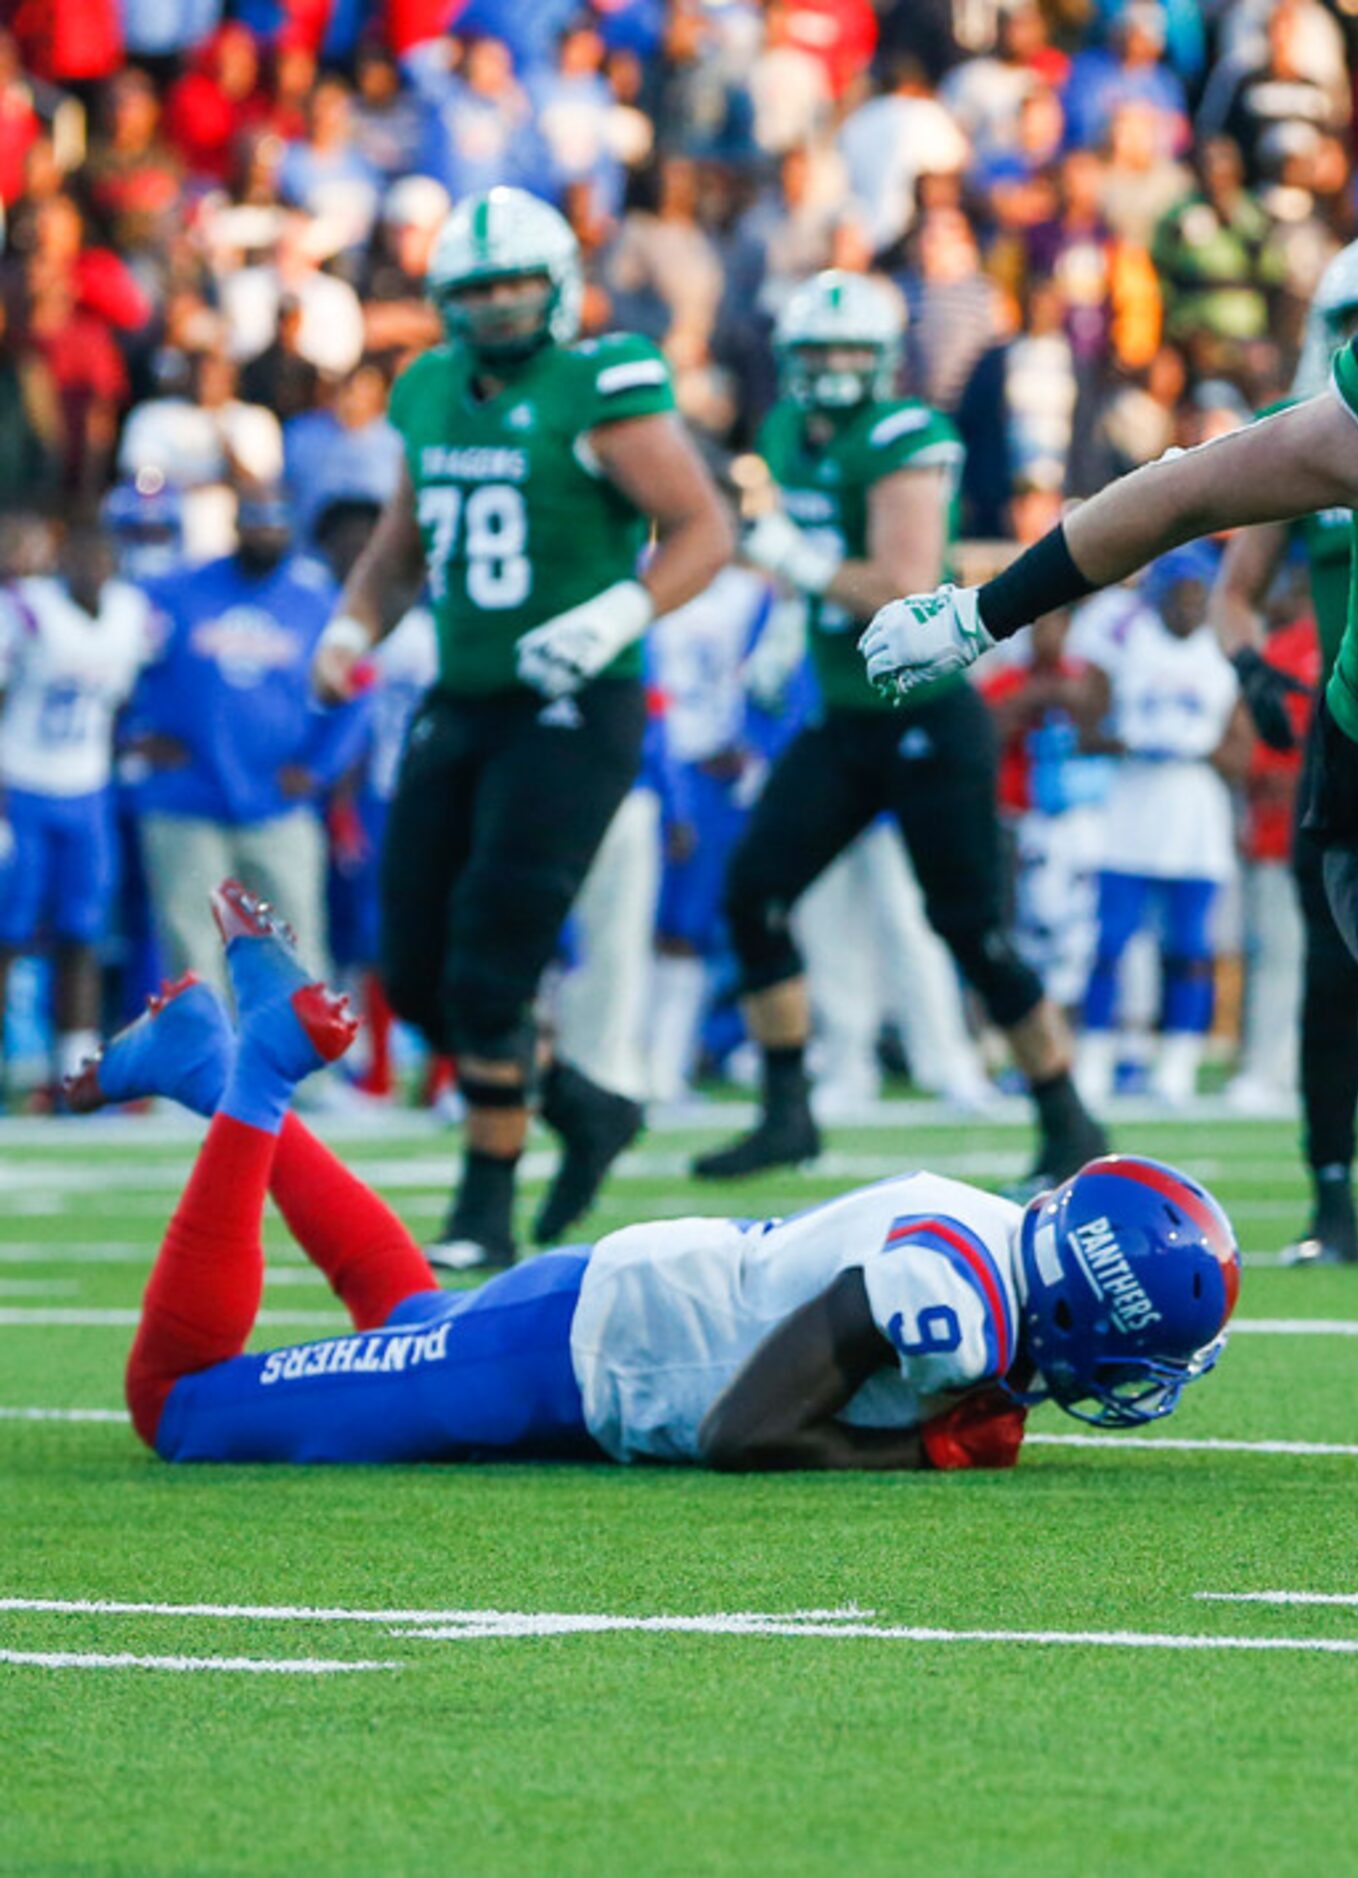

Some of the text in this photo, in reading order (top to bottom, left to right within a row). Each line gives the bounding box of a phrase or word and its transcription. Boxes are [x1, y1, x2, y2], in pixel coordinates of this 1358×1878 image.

[420, 485, 531, 609] 78
[889, 1305, 962, 1356] 9
[1076, 1216, 1161, 1331] PANTHERS
